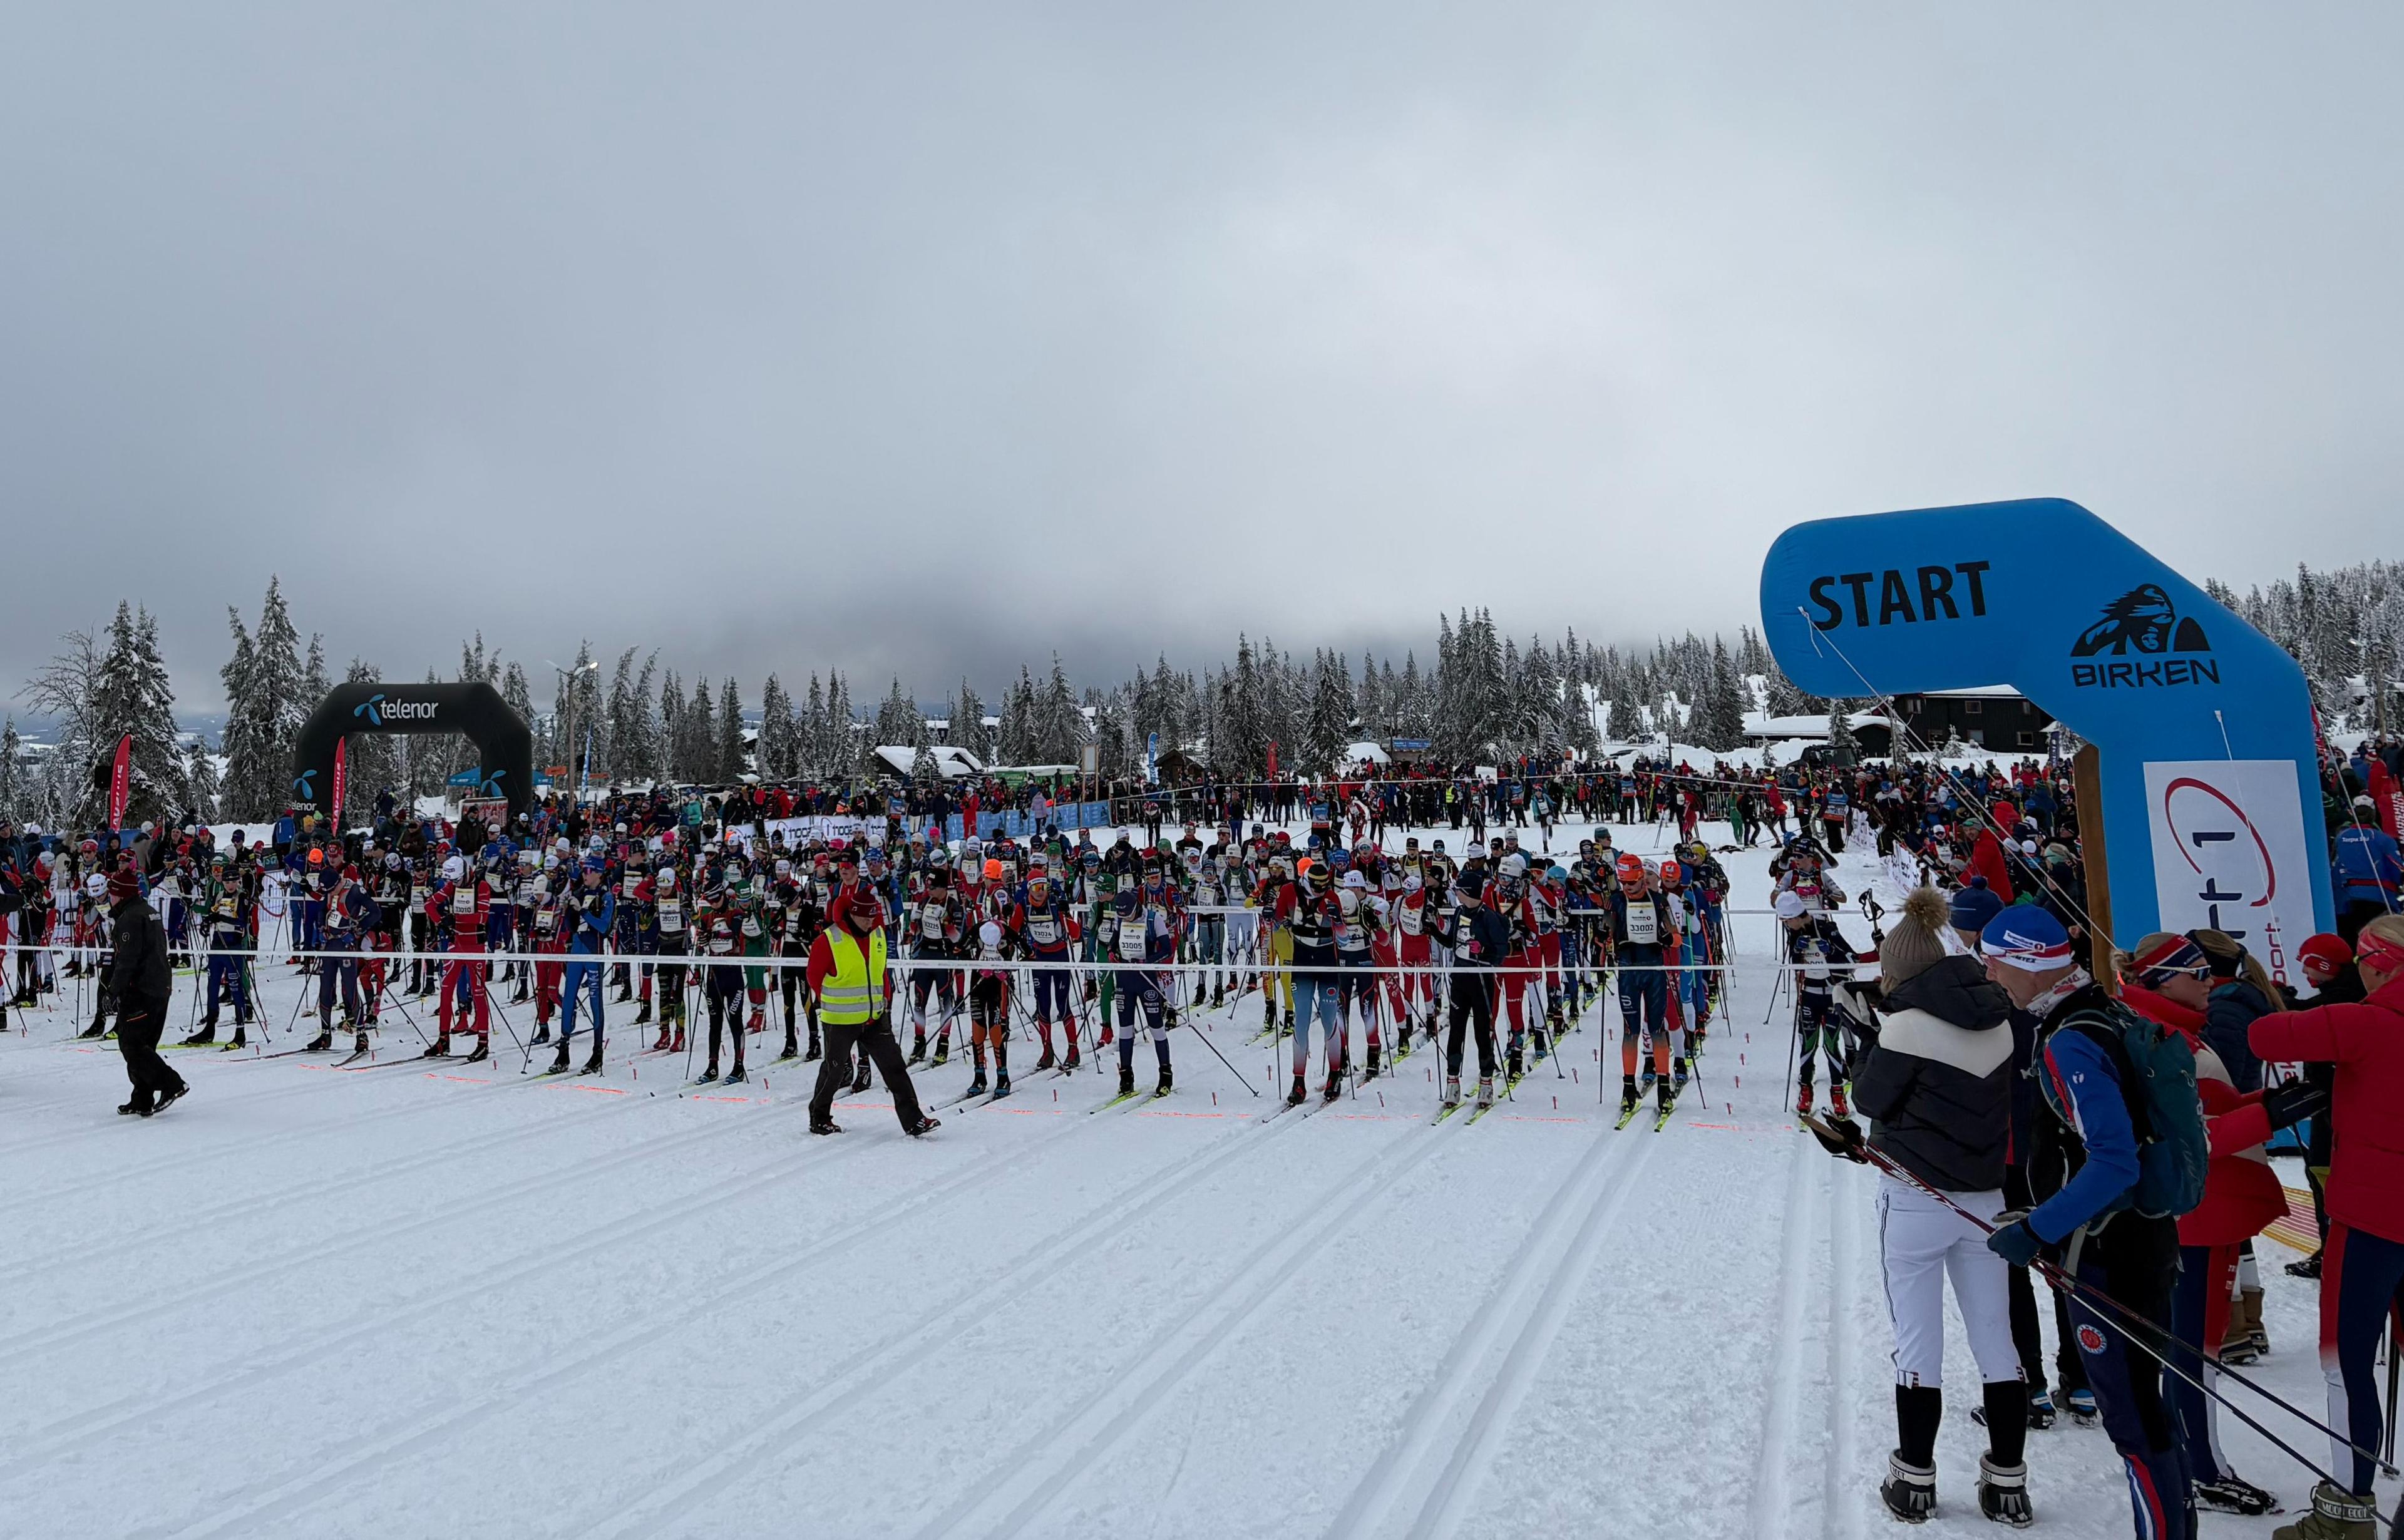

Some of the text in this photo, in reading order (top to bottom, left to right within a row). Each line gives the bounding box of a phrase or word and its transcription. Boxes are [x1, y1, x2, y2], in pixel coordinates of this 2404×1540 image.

[1809, 561, 1990, 631] START
[2072, 659, 2220, 688] BIRKEN
[381, 699, 438, 719] telenor
[291, 801, 317, 811] elenor
[1630, 924, 1654, 932] 33002
[1121, 942, 1143, 950] 33005
[729, 990, 744, 1015] FOSSUM
